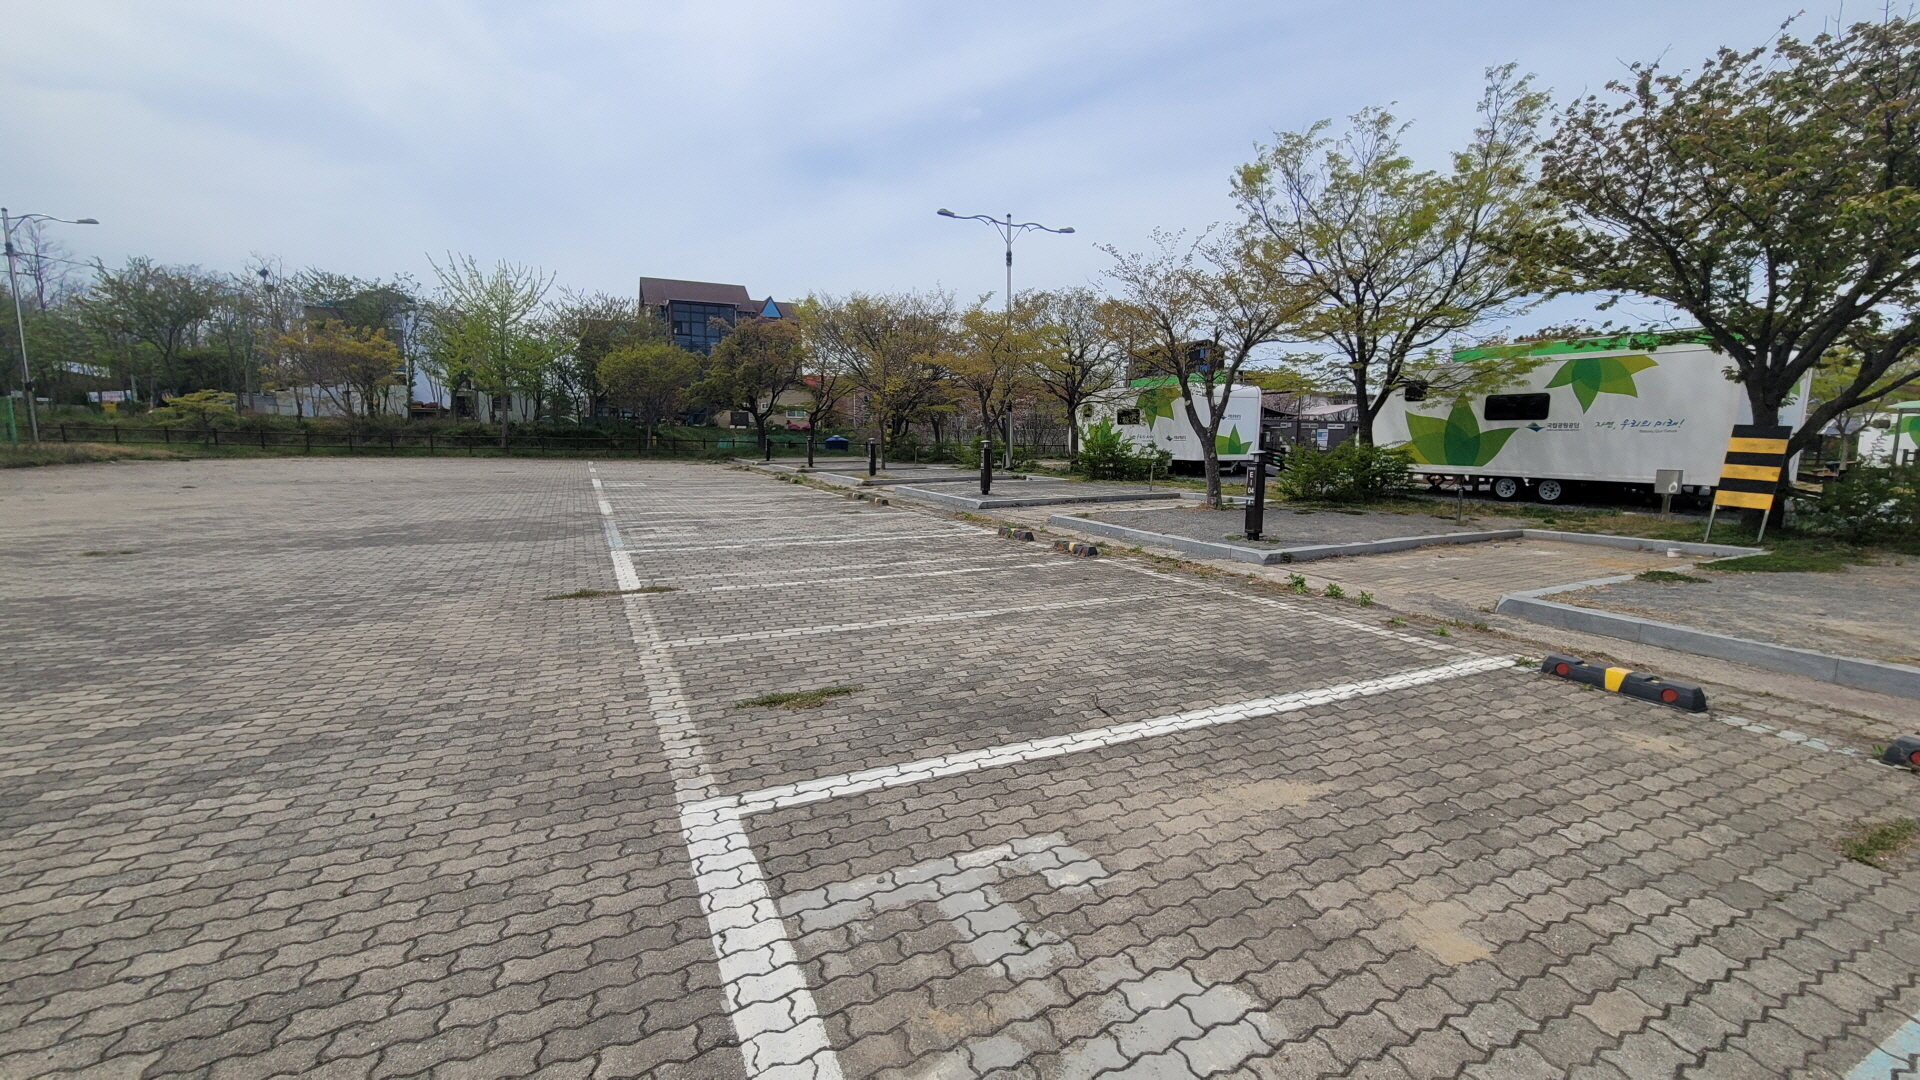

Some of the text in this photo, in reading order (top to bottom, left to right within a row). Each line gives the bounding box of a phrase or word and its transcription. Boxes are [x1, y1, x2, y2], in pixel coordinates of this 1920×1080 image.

[1595, 418, 1686, 431] 자연, 우리의 미래!
